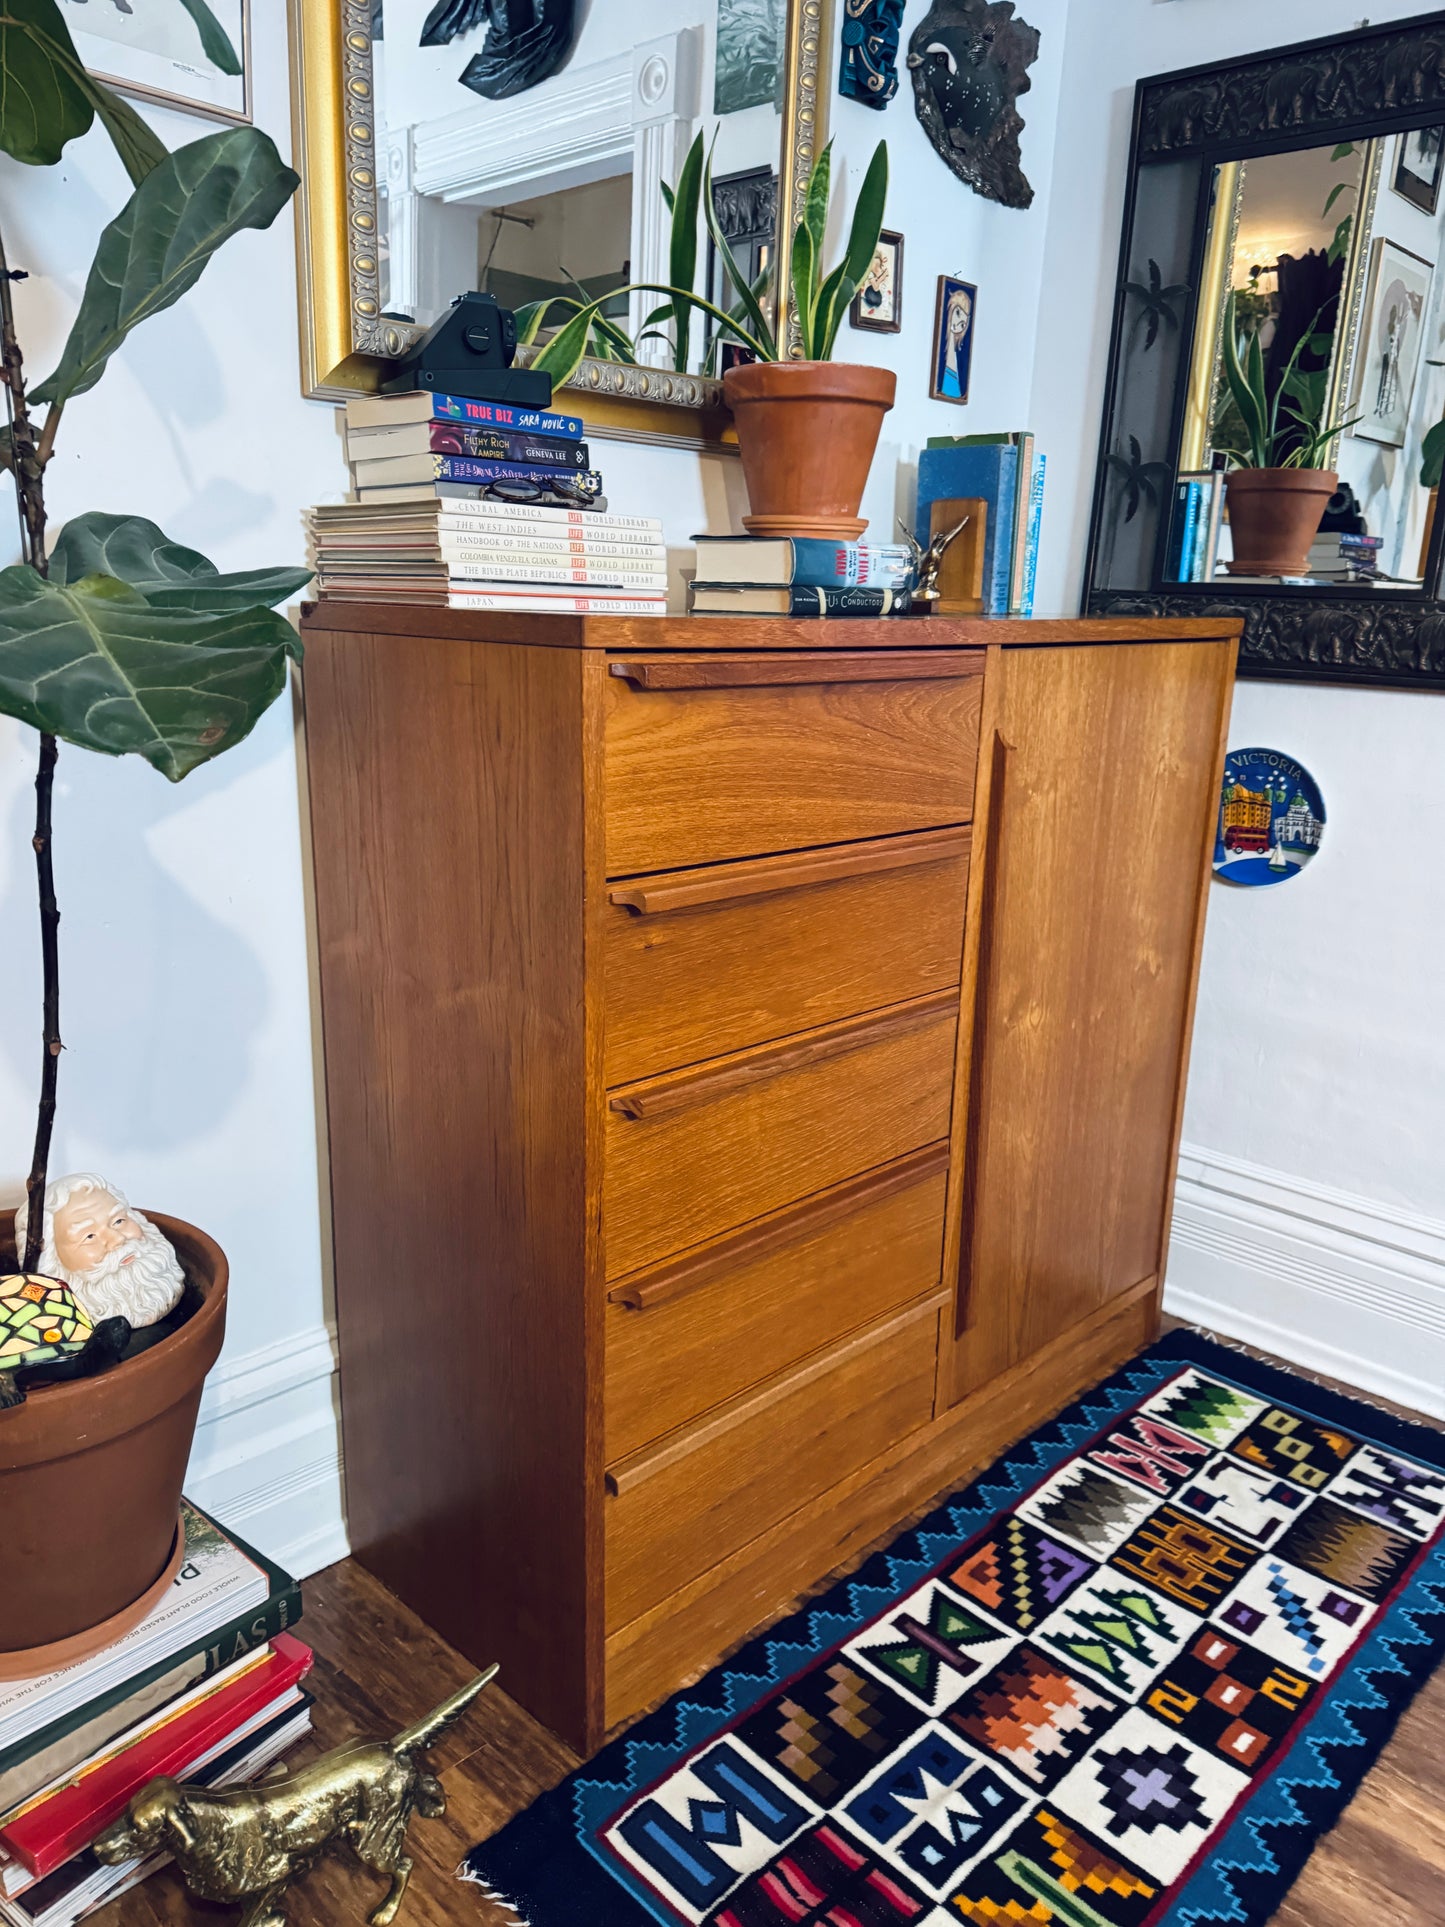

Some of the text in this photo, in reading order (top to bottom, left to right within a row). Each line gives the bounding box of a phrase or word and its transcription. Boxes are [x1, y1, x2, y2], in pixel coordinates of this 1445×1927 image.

[466, 403, 513, 423] TRUE BIZ
[518, 414, 539, 426] SARA
[525, 449, 567, 461] GENEVA LEE
[459, 503, 649, 528] CENTRAL AMERICA LIFE WORLD LIBRARY
[456, 521, 653, 543] THE WEST INDIES LIFE WORLD LIBRARY
[456, 536, 653, 556] HANDBOOK OF THE NATIONS LIFE WORLD LIBRARY
[572, 559, 585, 568] LIFE
[589, 560, 618, 569] WORLD
[622, 562, 654, 571] LIBRARY
[464, 566, 653, 584] THE RIVER PLATE REPUBLICS LIFE WORLD LIBRARY
[466, 597, 655, 610] JAPAN LIFE WORLD LIBRARY
[841, 595, 883, 608] CONDUCTORS
[1231, 752, 1302, 781] VICTORIA
[214, 1575, 240, 1593] WHOLE
[191, 1590, 214, 1605] FOOD
[34, 1676, 52, 1689] FOR
[16, 1687, 33, 1699] THE
